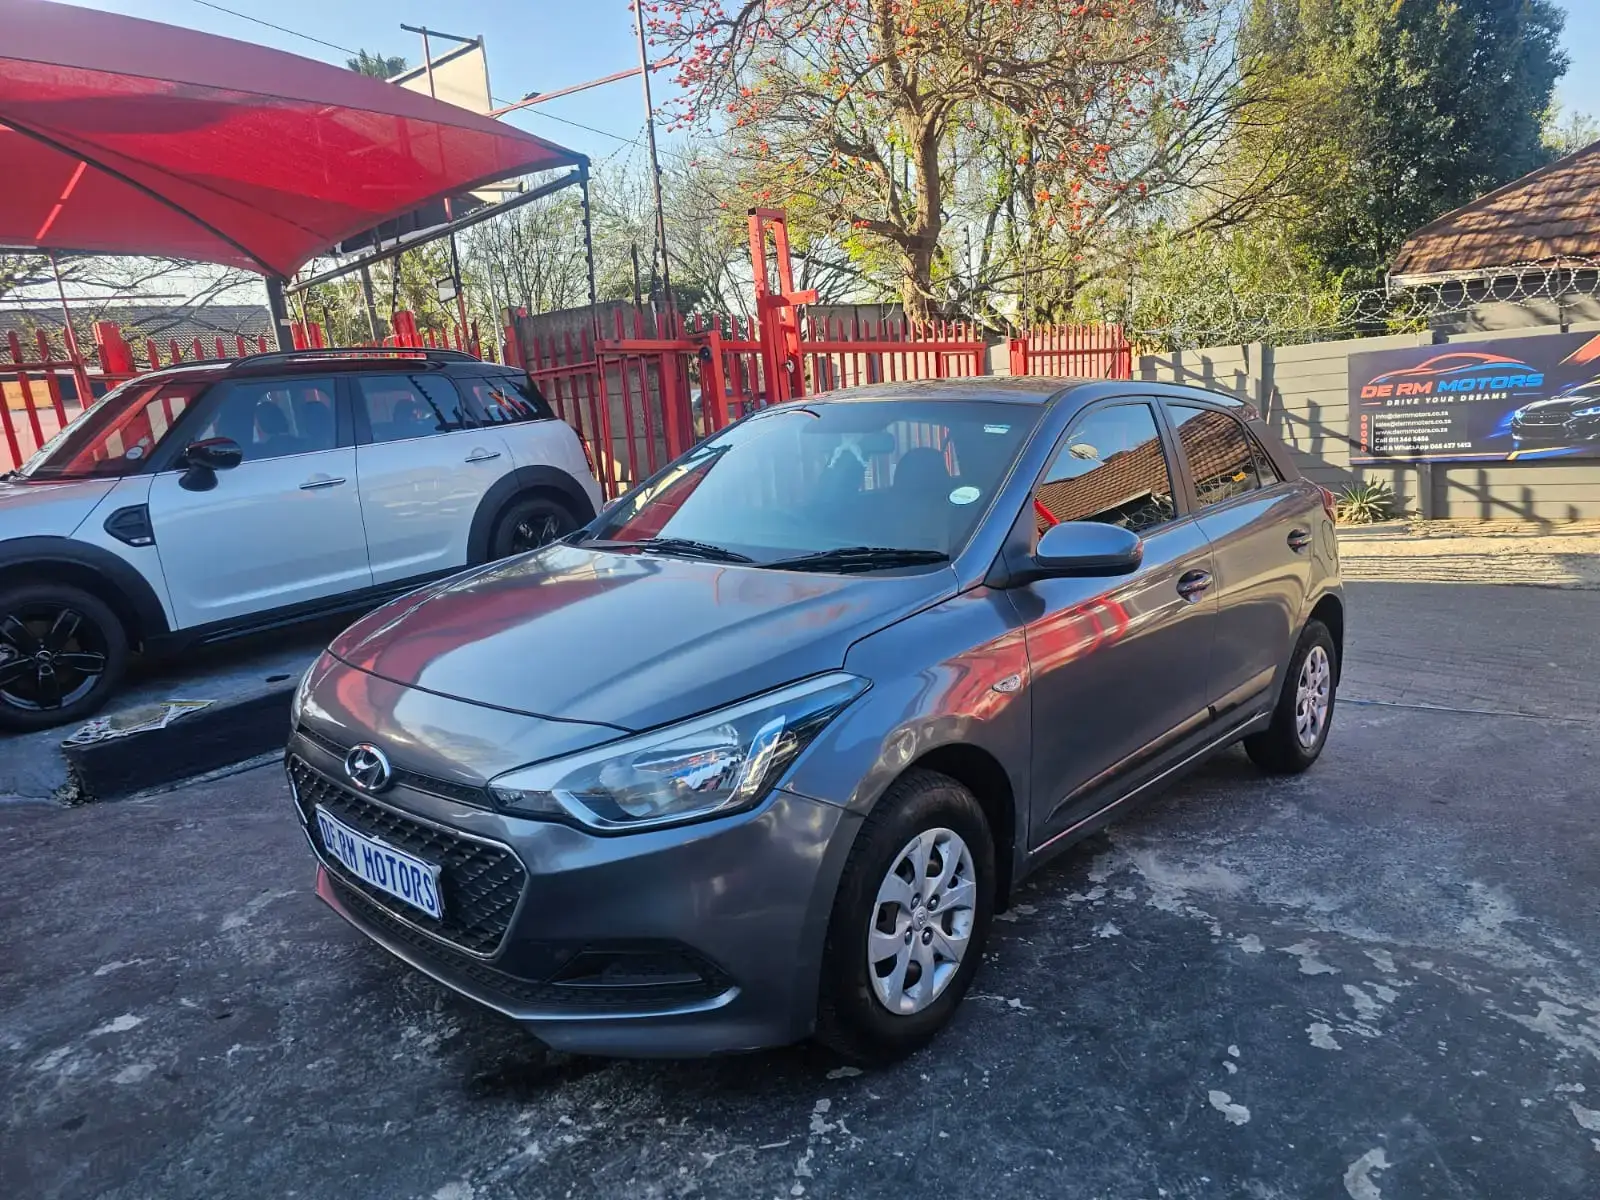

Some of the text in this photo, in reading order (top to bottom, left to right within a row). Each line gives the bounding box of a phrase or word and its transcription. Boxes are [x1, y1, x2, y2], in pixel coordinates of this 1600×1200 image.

[1360, 373, 1544, 399] DE RM MOTORS
[1386, 392, 1507, 407] DRIVE YOUR DREAMS
[319, 814, 436, 911] DE RM MOTORS
